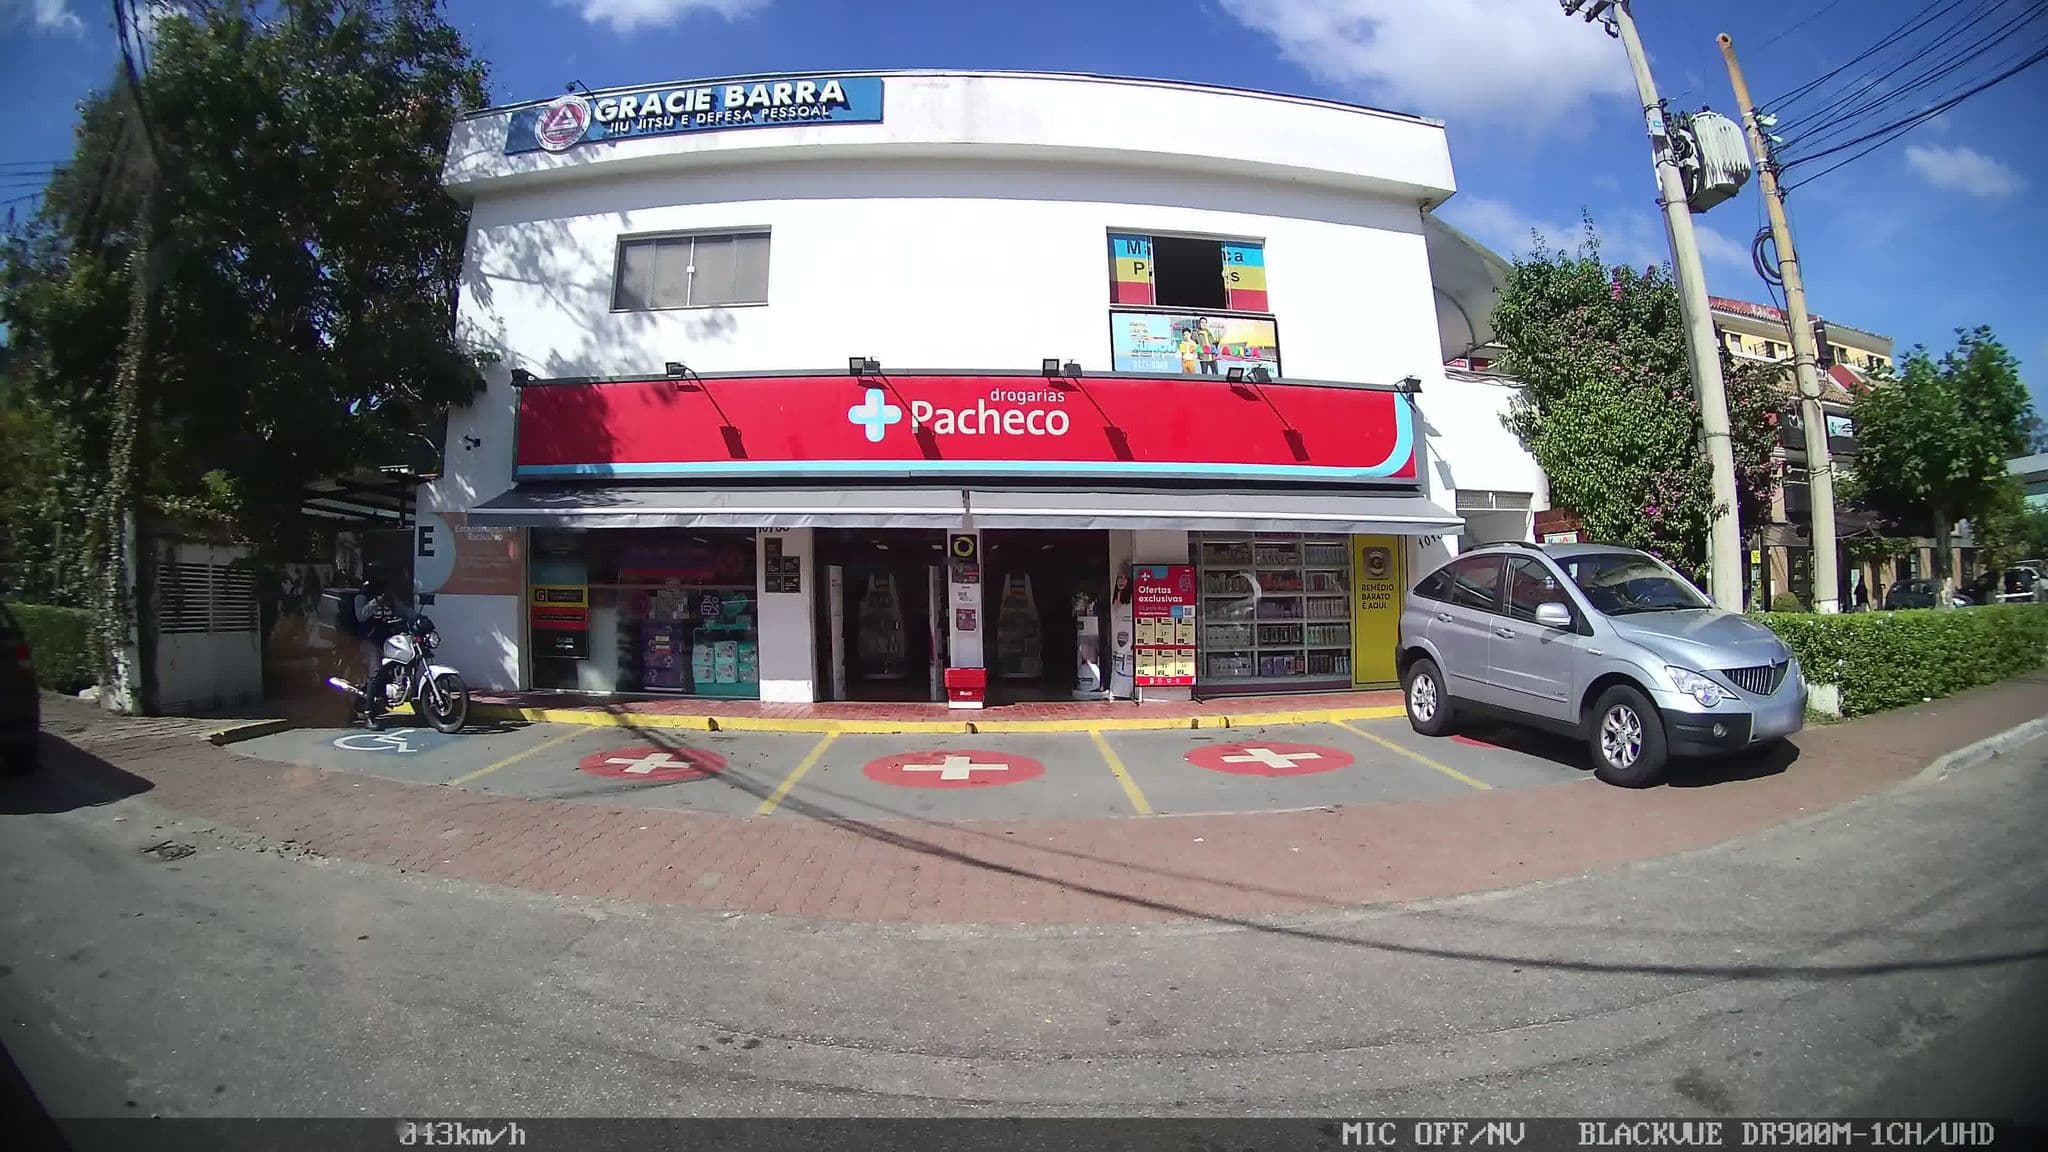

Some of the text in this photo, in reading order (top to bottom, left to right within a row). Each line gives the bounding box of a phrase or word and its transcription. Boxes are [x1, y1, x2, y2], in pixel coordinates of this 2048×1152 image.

[594, 80, 846, 122] GRACIE BARRA
[609, 104, 830, 135] JIU JITSU E DEFESA PESSOAL
[990, 388, 1065, 405] drogarias
[911, 398, 1070, 436] Pacheco
[418, 526, 435, 557] E
[1138, 585, 1171, 594] Ofertas
[1138, 594, 1183, 603] exclusivas
[1361, 593, 1391, 601] BARATO
